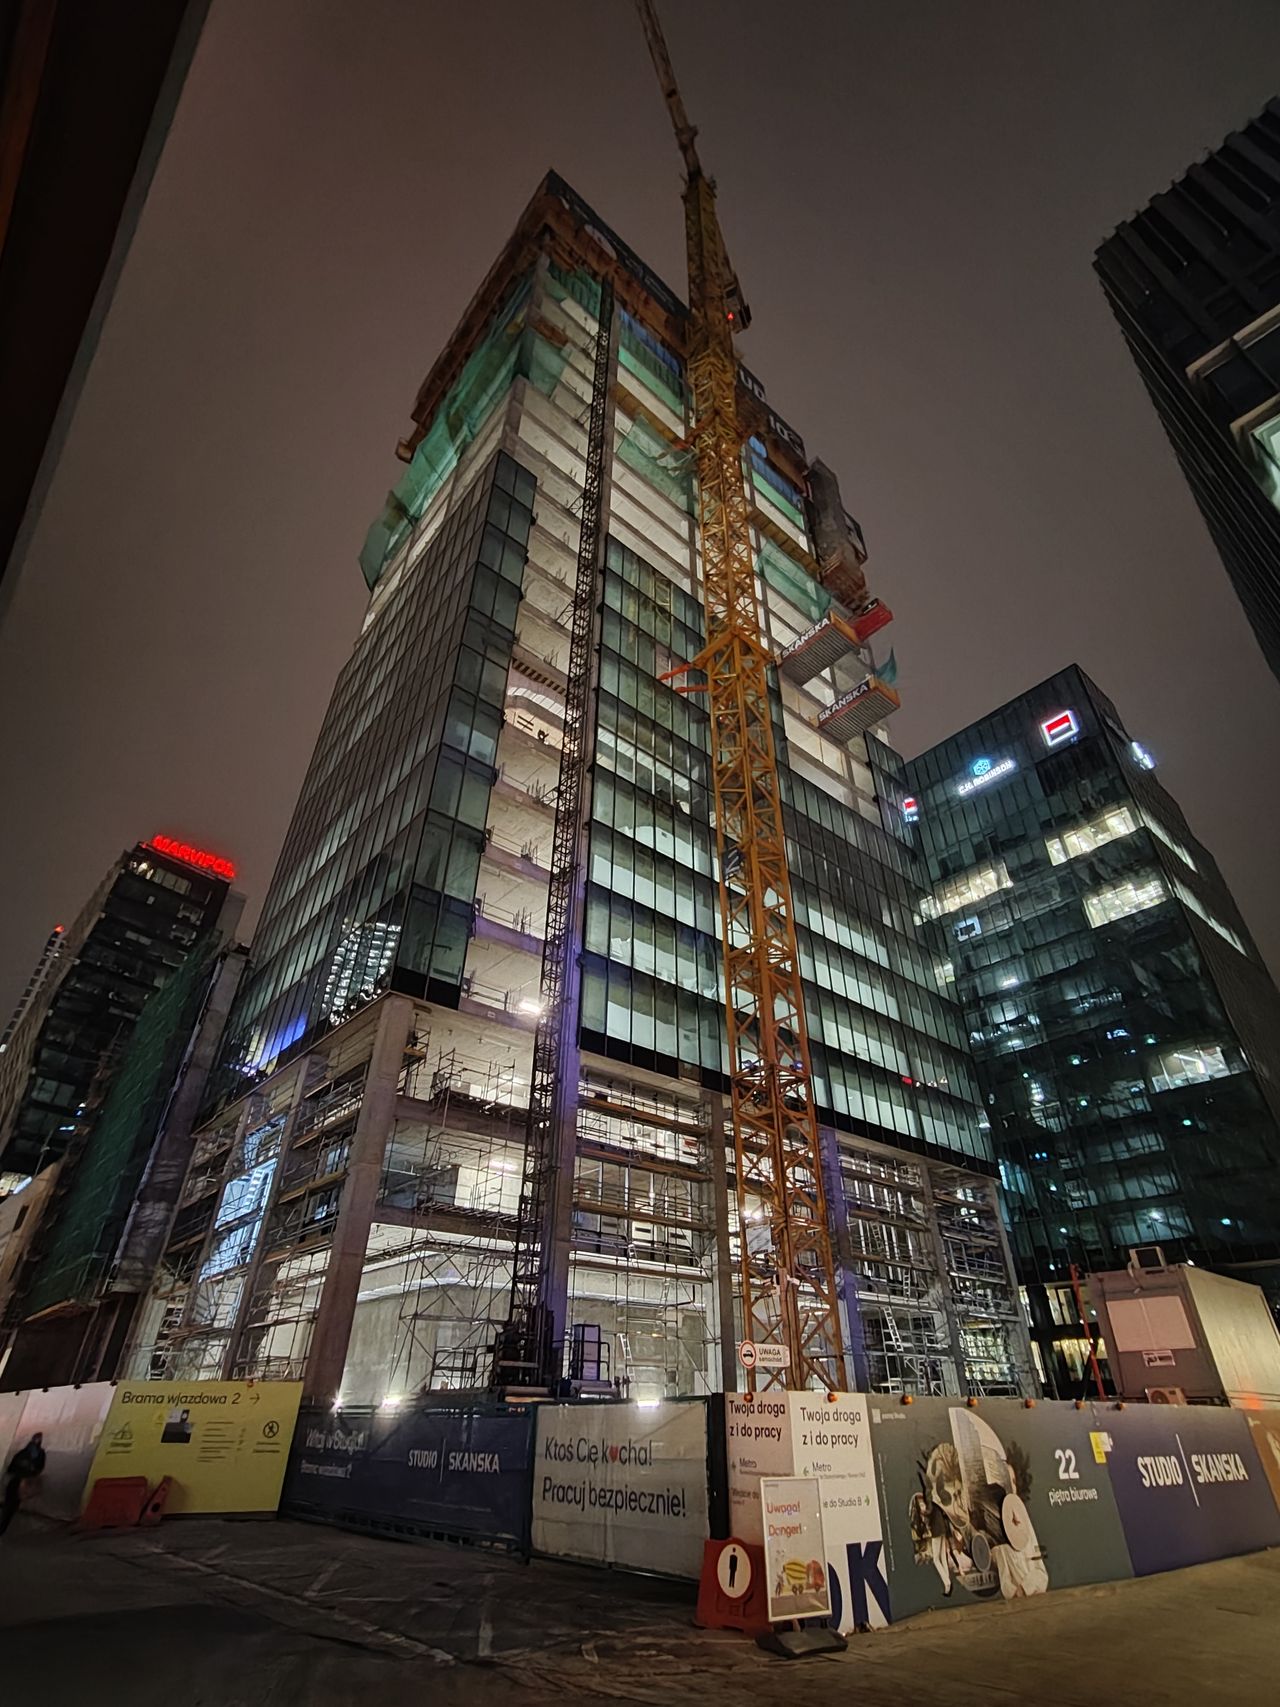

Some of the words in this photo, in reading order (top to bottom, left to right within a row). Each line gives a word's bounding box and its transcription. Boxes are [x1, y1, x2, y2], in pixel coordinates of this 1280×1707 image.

[782, 617, 830, 658] SKANSKA
[818, 684, 869, 721] SKANSKA
[759, 1348, 781, 1356] UWAGA
[121, 1391, 165, 1404] Brama
[167, 1392, 228, 1407] wjazdowa
[231, 1392, 241, 1405] 2
[729, 1400, 755, 1419] Twoja
[757, 1401, 786, 1419] droga
[800, 1407, 830, 1425] Twoja
[832, 1409, 861, 1425] droga
[729, 1426, 735, 1437] z
[740, 1424, 753, 1437] do
[754, 1426, 782, 1442] pracy
[802, 1434, 808, 1446] z
[816, 1431, 829, 1446] do
[831, 1433, 859, 1449] pracy
[408, 1449, 438, 1469] STUDIO
[448, 1452, 500, 1473] SKANSKA
[544, 1437, 575, 1462] Ktoś
[576, 1437, 598, 1469] Cię
[601, 1439, 652, 1466] kcha!
[812, 1461, 832, 1472] Metro
[1055, 1449, 1080, 1480] 22
[1137, 1455, 1184, 1488] STUDIO
[1191, 1453, 1249, 1484] SKANSKA
[542, 1476, 586, 1511] Pracuj
[588, 1480, 687, 1518] bezpiecznie!
[1071, 1487, 1098, 1502] biurowe
[766, 1501, 801, 1516] Uwaga!
[768, 1524, 803, 1538] Danger!
